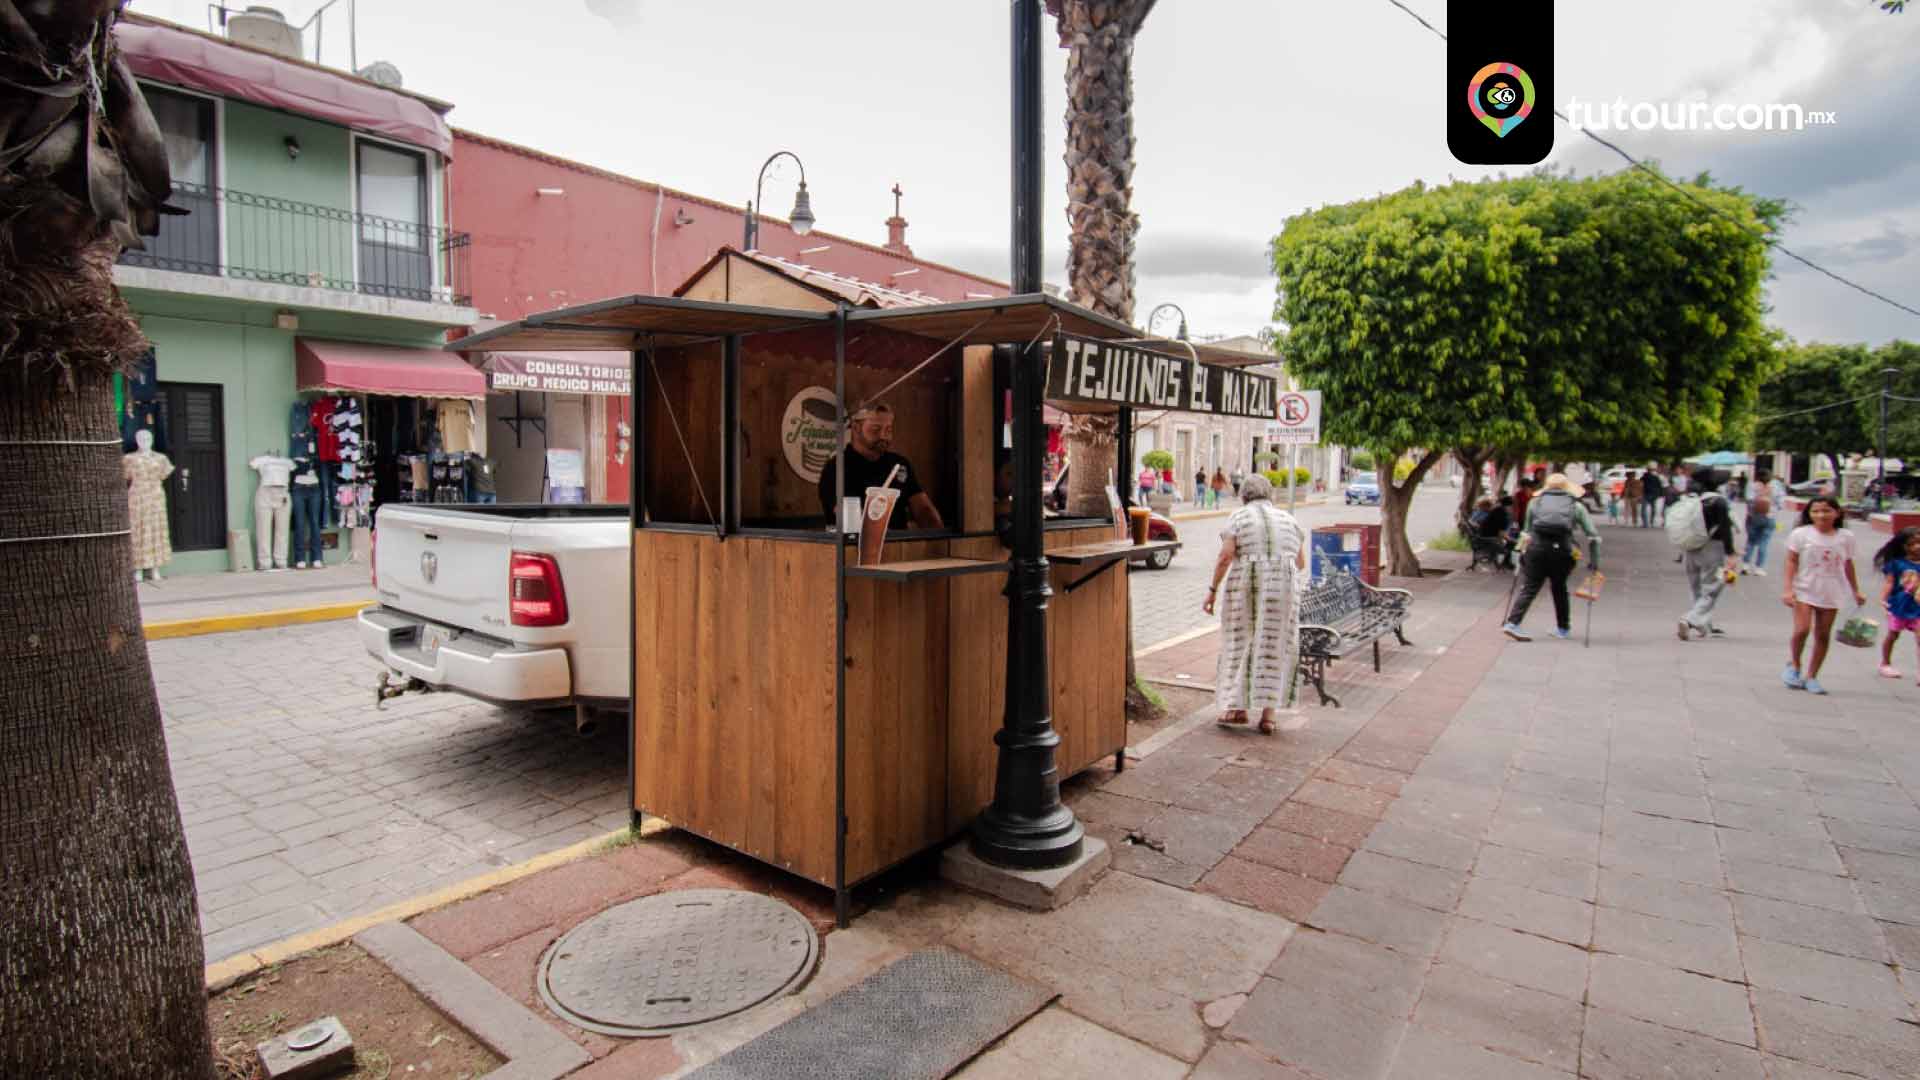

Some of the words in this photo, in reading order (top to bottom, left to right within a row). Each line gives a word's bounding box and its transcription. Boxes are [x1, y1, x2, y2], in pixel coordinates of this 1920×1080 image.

[526, 360, 631, 379] CONSULTORIOS
[1063, 340, 1181, 407] TEJUINOS
[1190, 365, 1212, 411] EL
[1222, 370, 1274, 417] MAIZAL
[493, 372, 538, 388] GRUPO
[543, 376, 589, 391] MEDICO
